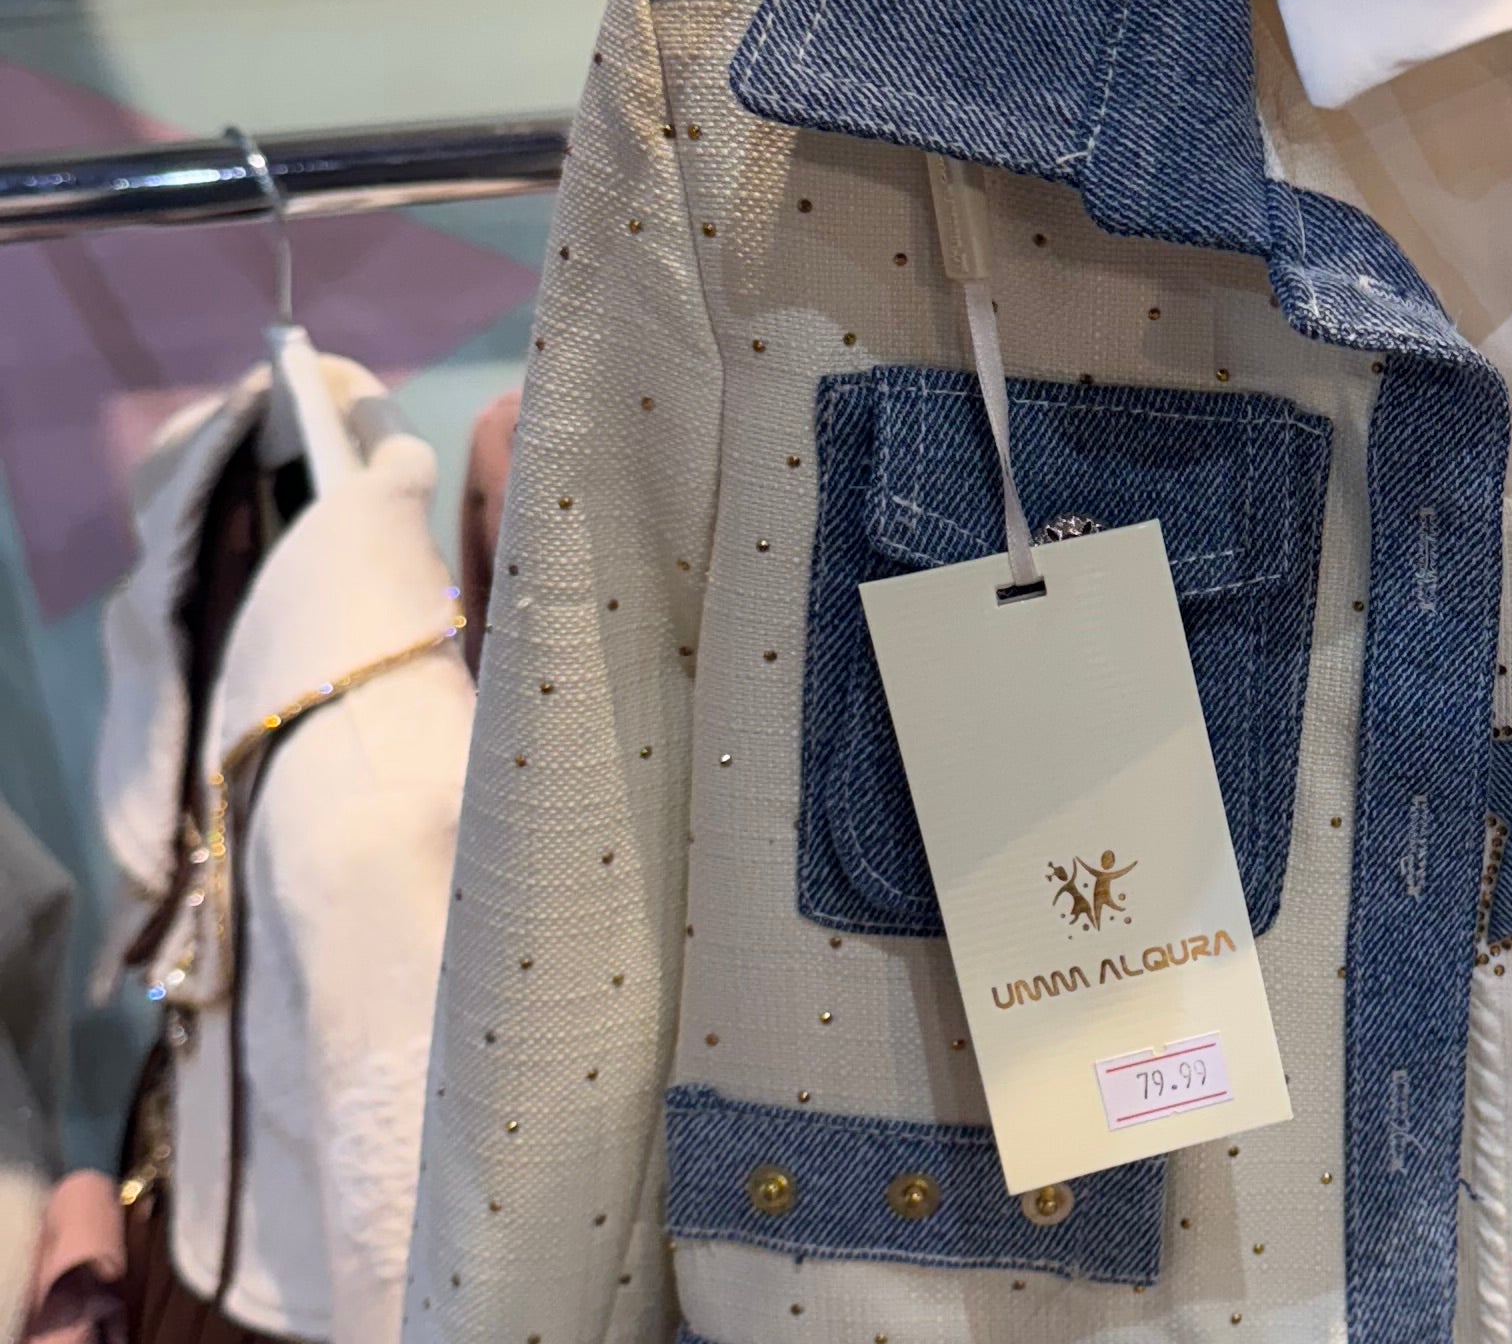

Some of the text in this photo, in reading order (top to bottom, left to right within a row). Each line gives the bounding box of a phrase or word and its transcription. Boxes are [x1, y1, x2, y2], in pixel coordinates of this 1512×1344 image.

[991, 930, 1236, 1009] UMM ALQURA
[1136, 1059, 1208, 1100] 79.99
